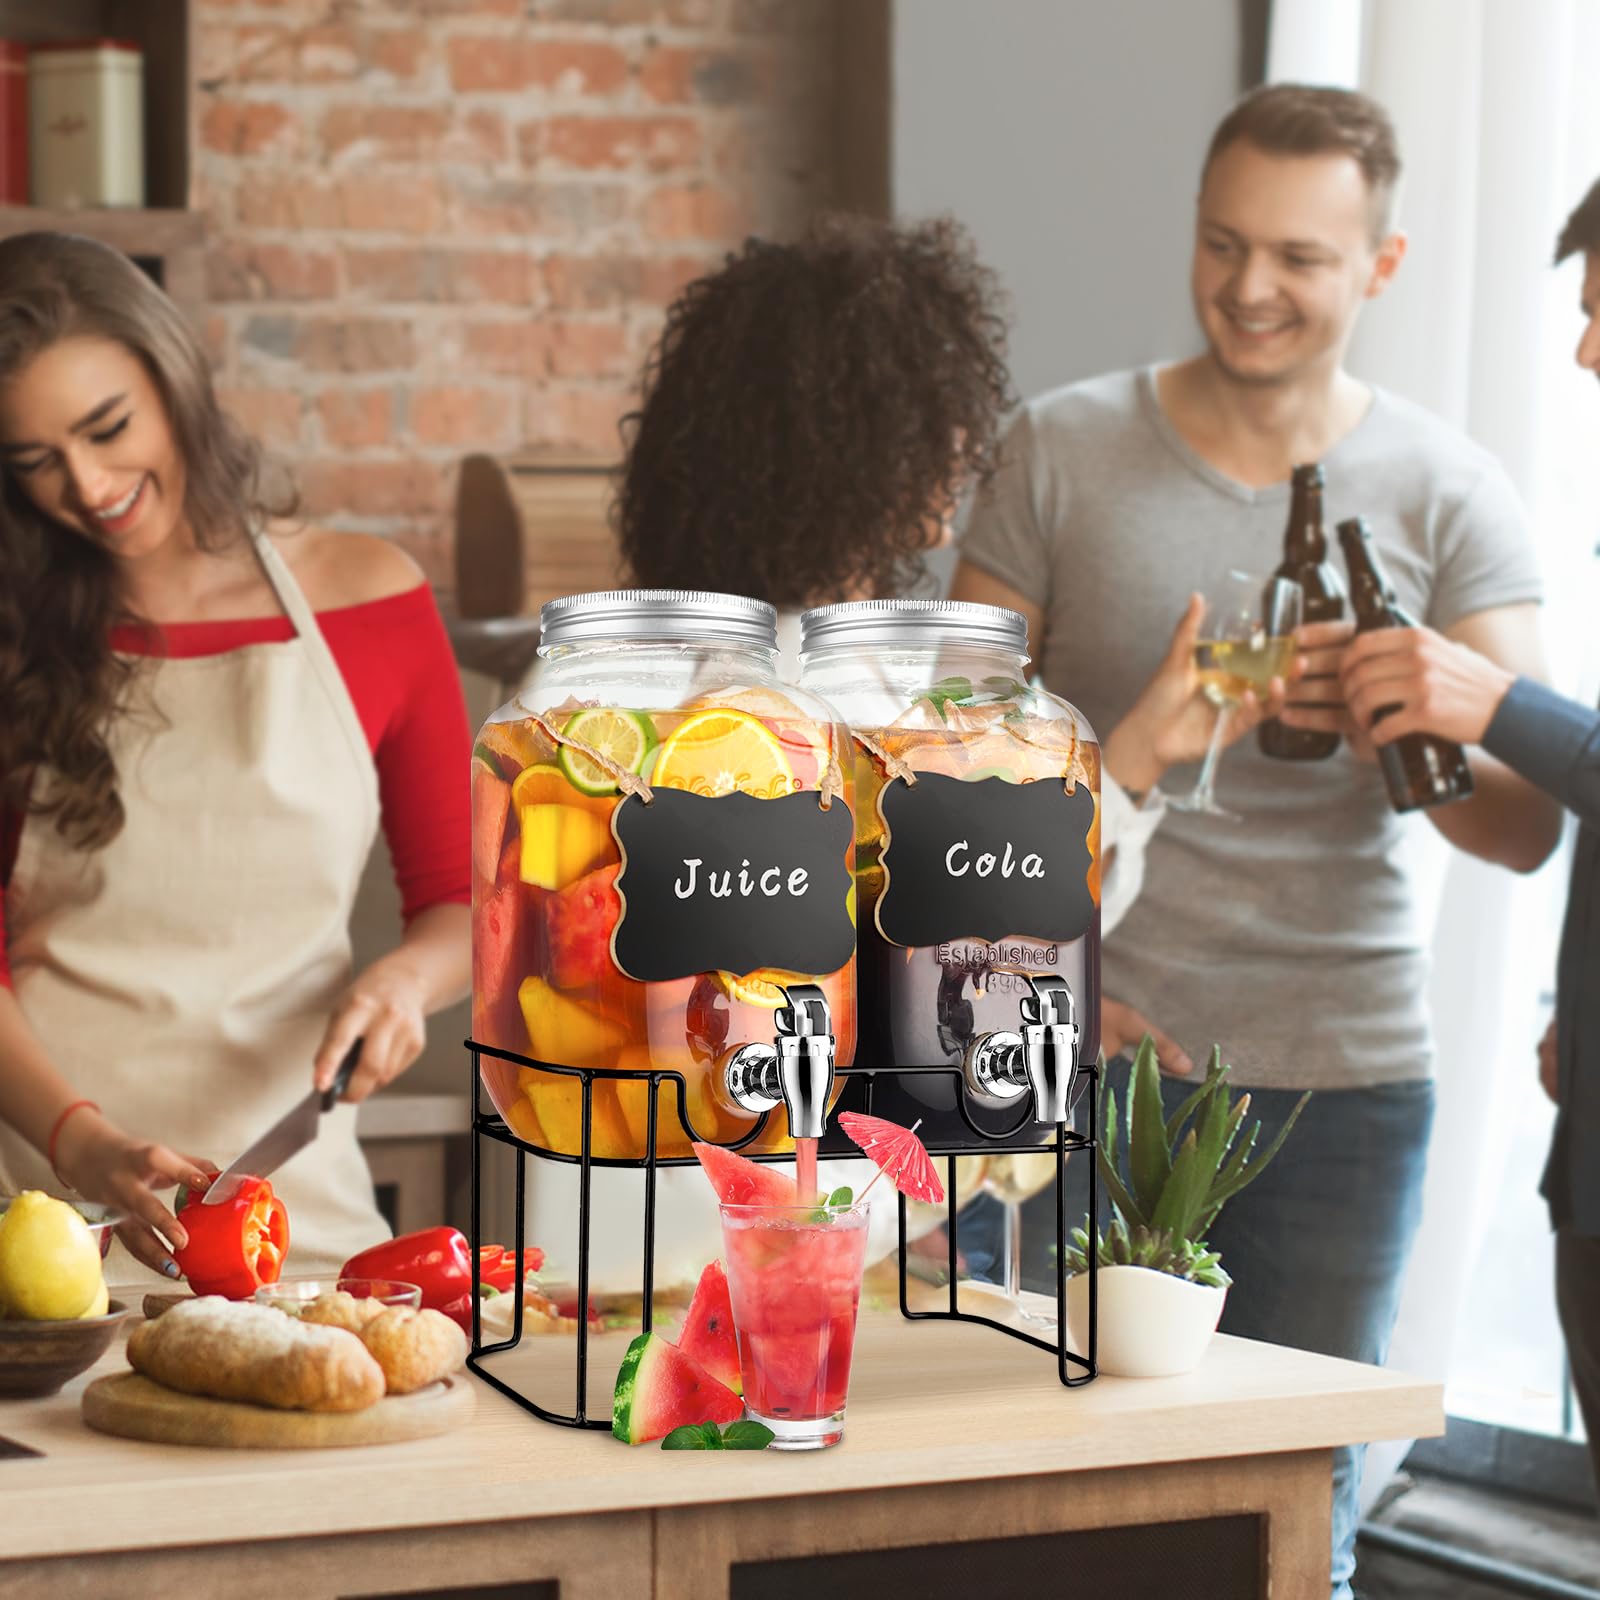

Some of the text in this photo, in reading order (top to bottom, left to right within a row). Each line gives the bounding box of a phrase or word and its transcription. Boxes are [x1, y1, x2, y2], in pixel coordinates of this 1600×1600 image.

[674, 858, 809, 899] Juice
[945, 839, 1046, 879] Cola
[935, 943, 1058, 965] Established
